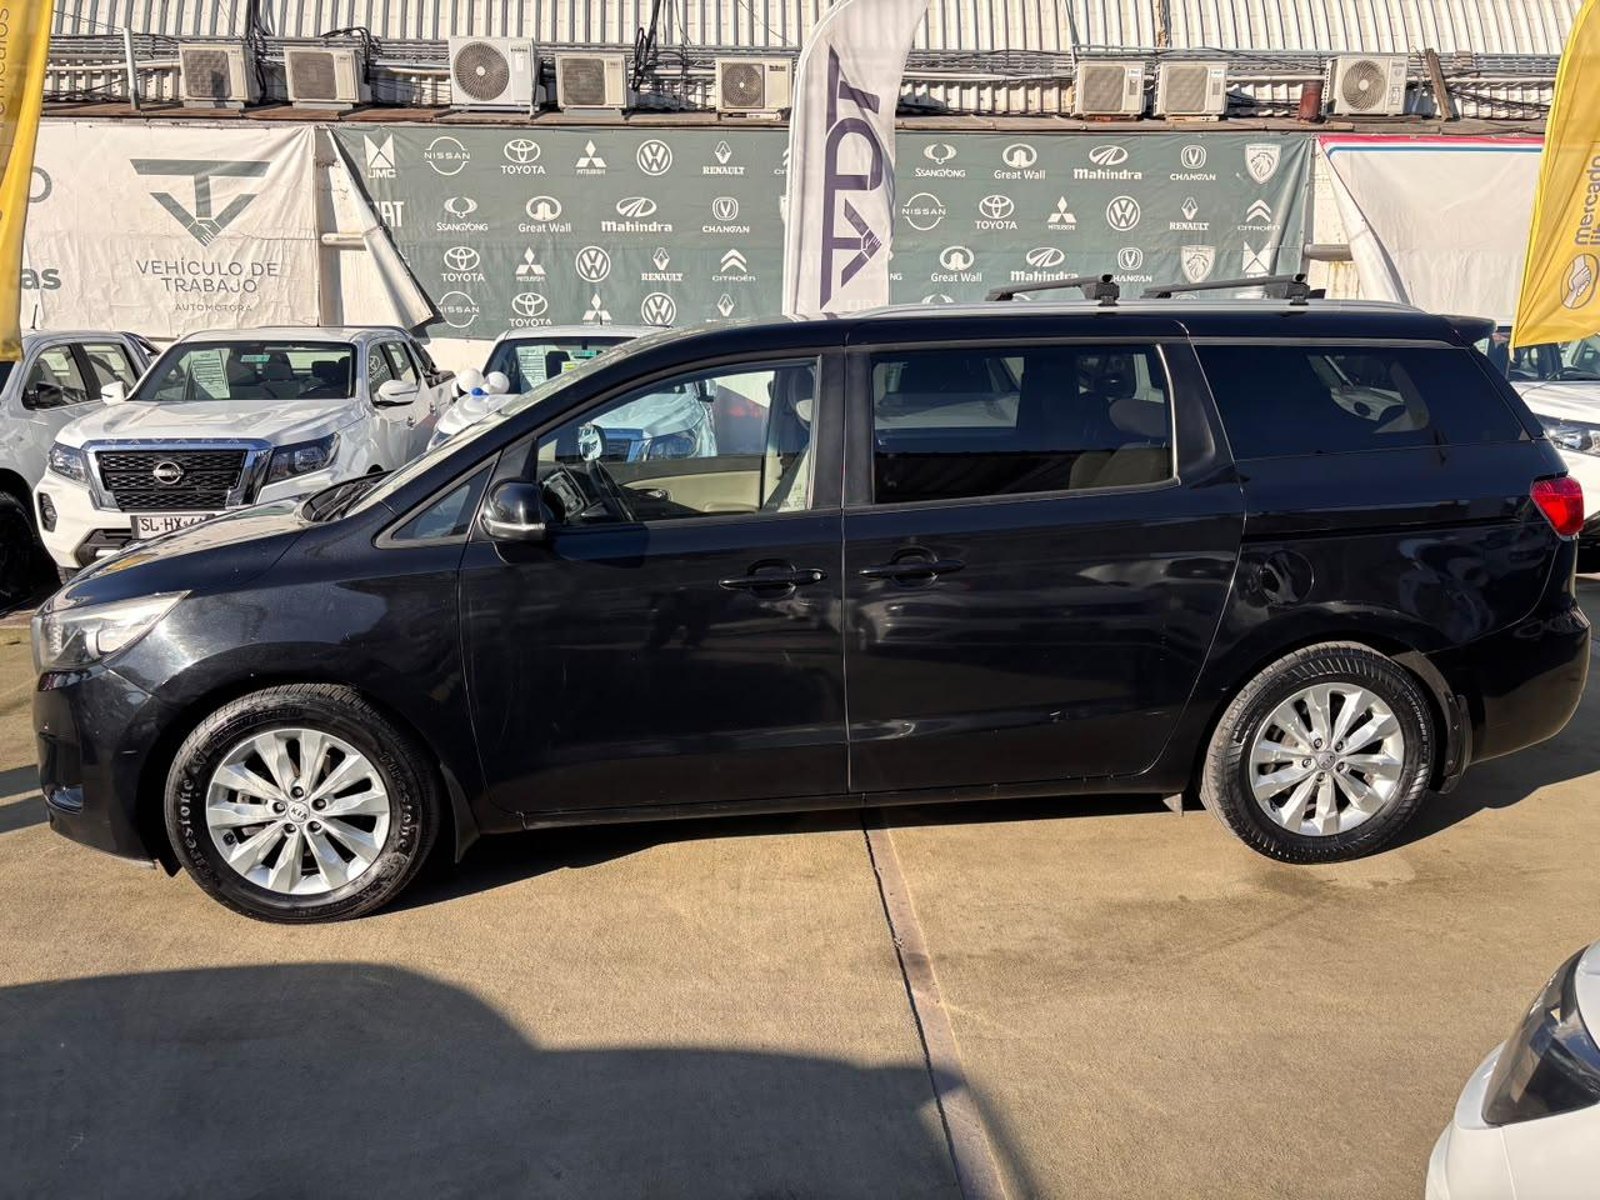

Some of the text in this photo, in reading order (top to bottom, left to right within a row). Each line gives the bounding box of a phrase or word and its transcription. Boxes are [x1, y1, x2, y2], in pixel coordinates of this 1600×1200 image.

[368, 168, 397, 178] JMC
[501, 165, 545, 175] TOYOTA
[702, 166, 745, 175] RENAULT
[994, 169, 1046, 180] Great Wall
[1073, 168, 1143, 180] Mahindra
[1169, 173, 1216, 181] CHANGAN
[902, 207, 946, 215] NISSAN
[518, 223, 572, 233] Great Wall
[601, 220, 673, 232] Mahindra
[702, 225, 750, 234] CHANGAN
[975, 220, 1018, 230] TOYOTA
[1169, 222, 1210, 231] RENAULT
[136, 257, 279, 277] VEHÍCULO DE
[441, 273, 486, 282] TOYOTA
[641, 273, 683, 281] RENAULT
[930, 273, 982, 282] Great Wall
[1113, 275, 1152, 283] HANGAN
[160, 278, 257, 293] TRABAJO
[175, 303, 252, 312] AUTOMOTORA
[509, 318, 552, 327] TOYOTA
[291, 806, 308, 820] KIA
